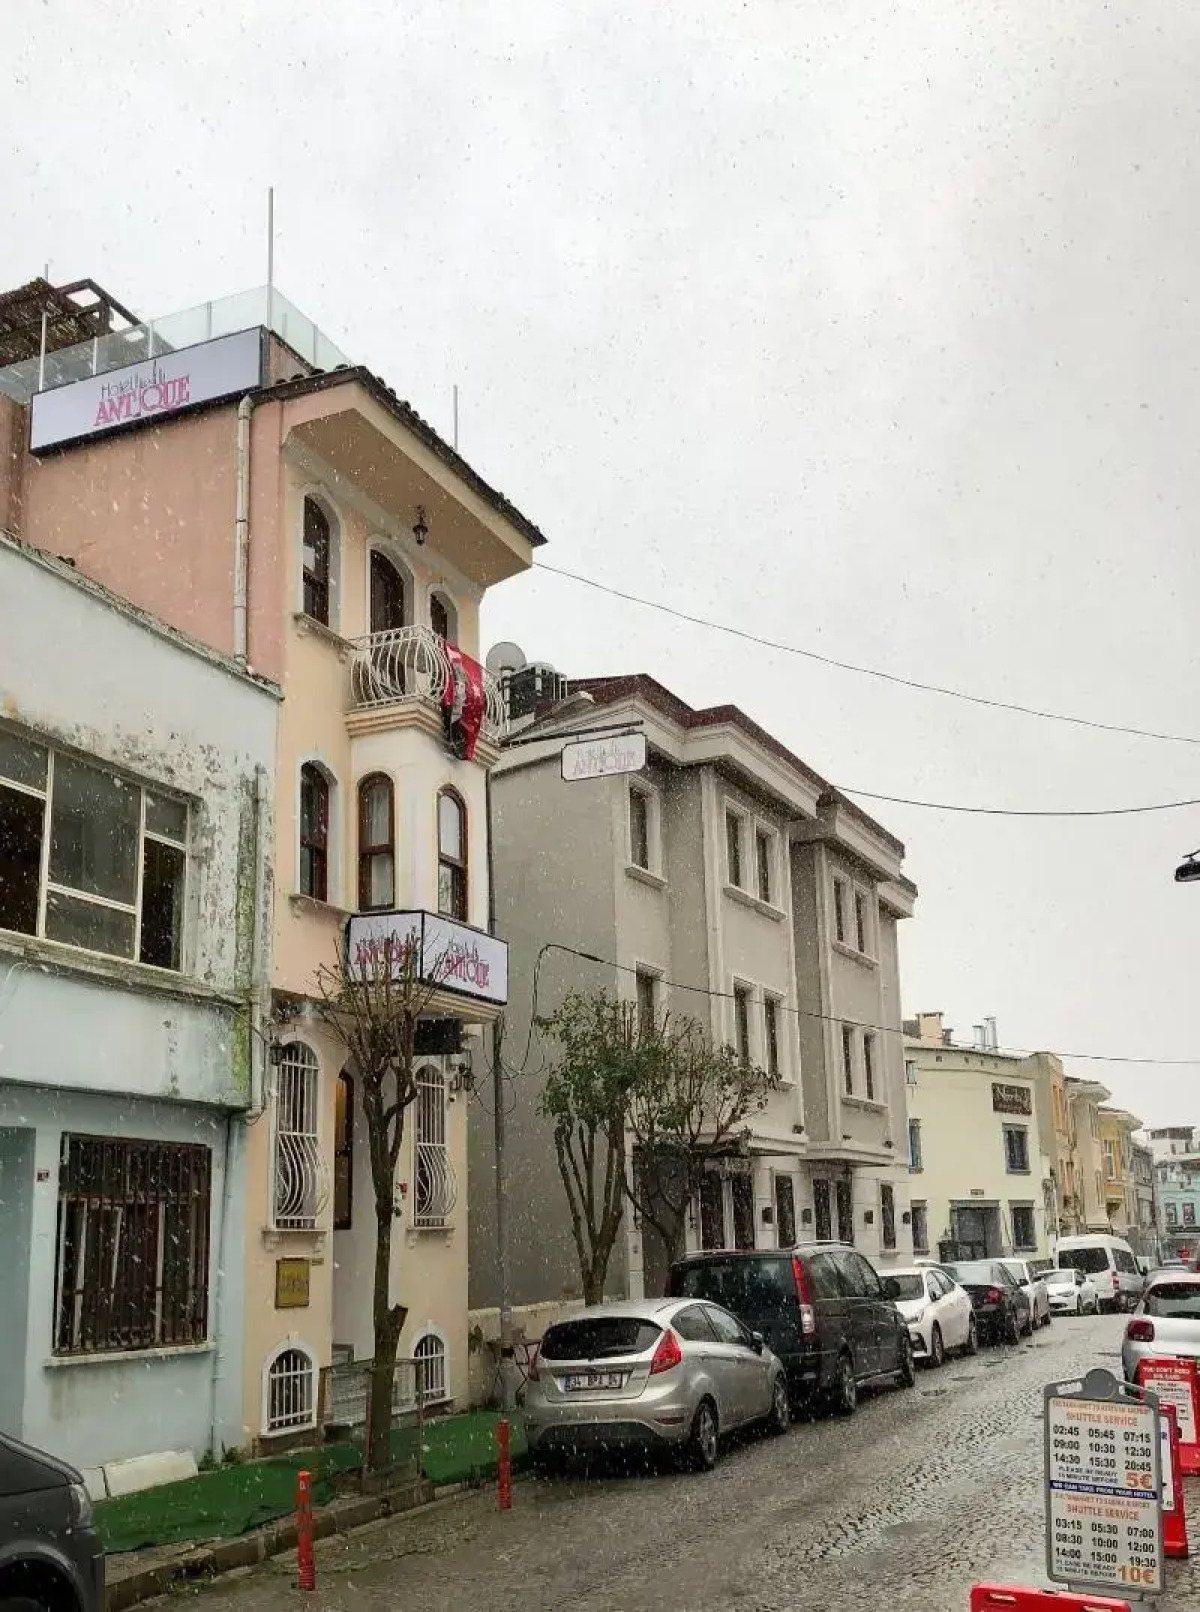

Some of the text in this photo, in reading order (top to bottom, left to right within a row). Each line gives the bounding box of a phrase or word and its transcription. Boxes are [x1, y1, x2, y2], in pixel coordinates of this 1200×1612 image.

[93, 374, 190, 426] ANTIQUE
[1066, 1412, 1102, 1423] SHUTTLE
[1053, 1424, 1080, 1436] 02:45
[1088, 1428, 1115, 1440] 05:45
[1123, 1432, 1151, 1443] 07:15
[1053, 1439, 1151, 1458] 09:00 10:30 12:30
[1053, 1453, 1152, 1472] 14:30 15:30 20:45
[1127, 1472, 1152, 1489] 5€
[1133, 1491, 1155, 1499] HOTEL
[1066, 1504, 1103, 1517] SHUTTLE
[1055, 1518, 1154, 1539] 03:15 05:30 07:00
[1055, 1532, 1154, 1553] 08:30 10:00 12:00
[1055, 1547, 1156, 1568] 14:00 15:00 19:30
[1118, 1565, 1154, 1584] 10€
